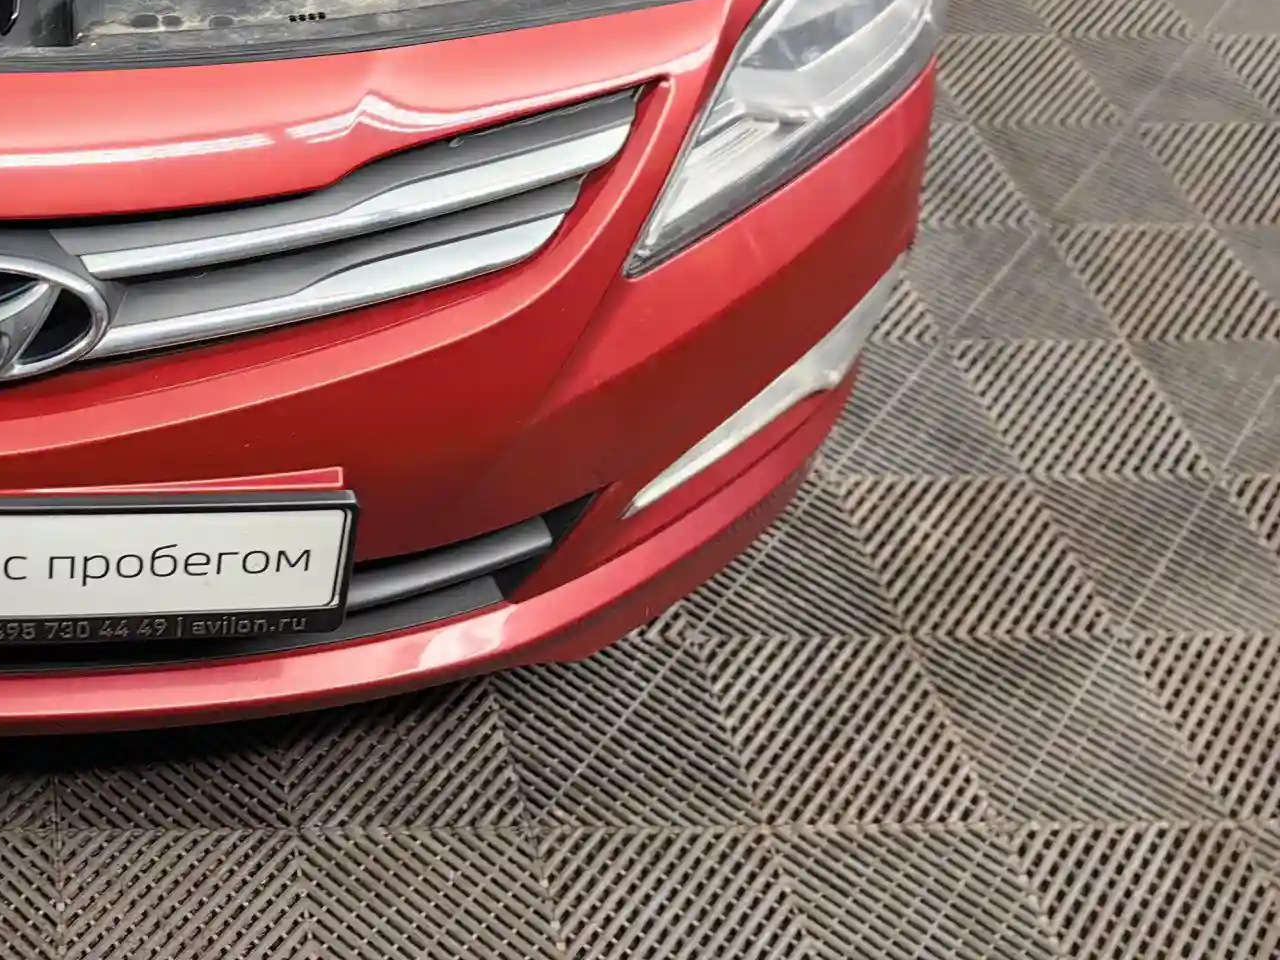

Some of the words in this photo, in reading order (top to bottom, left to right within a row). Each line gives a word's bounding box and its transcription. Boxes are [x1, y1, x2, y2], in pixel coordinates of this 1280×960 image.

[3, 556, 28, 580] с
[48, 543, 311, 587] пробегом
[44, 621, 90, 639] 730
[99, 620, 130, 638] 44
[137, 618, 167, 637] 49
[192, 615, 307, 636] avilon.ru
